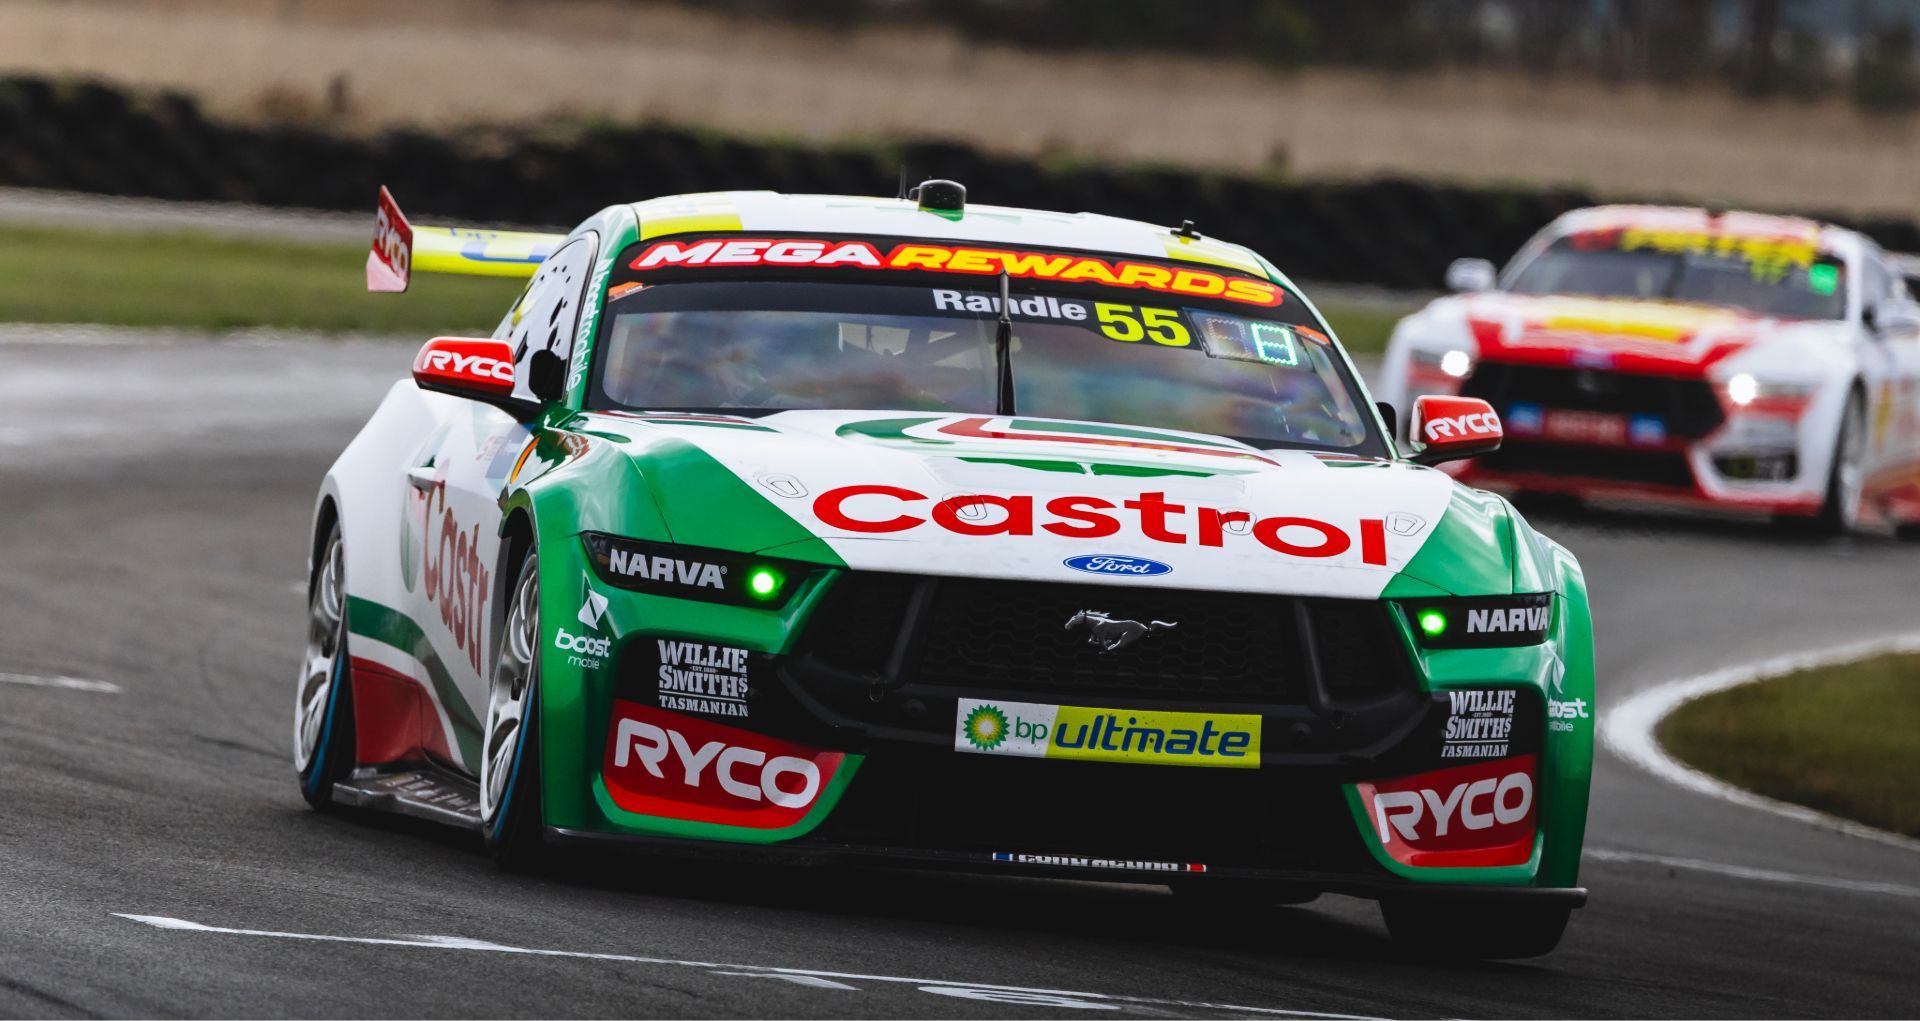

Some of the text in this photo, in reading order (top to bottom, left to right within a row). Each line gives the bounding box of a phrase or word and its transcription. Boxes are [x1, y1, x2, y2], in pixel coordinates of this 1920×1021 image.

[375, 205, 408, 271] RYCO
[638, 242, 1275, 304] MEGA REWARDS
[932, 289, 1191, 347] Randle 55
[422, 350, 515, 382] RYCO
[1425, 413, 1502, 440] RYCO
[812, 484, 1388, 566] Castrol
[1086, 557, 1150, 574] Ford
[554, 627, 612, 658] boost
[657, 639, 748, 674] WILLIE
[568, 655, 600, 670] mobile
[659, 694, 749, 717] TASMANIAN
[1449, 690, 1516, 714] WILLIE
[1015, 715, 1250, 757] bp ultimate
[1441, 744, 1508, 758] TASMANIAN
[614, 717, 820, 809] RYCO
[1374, 772, 1533, 844] RYCO
